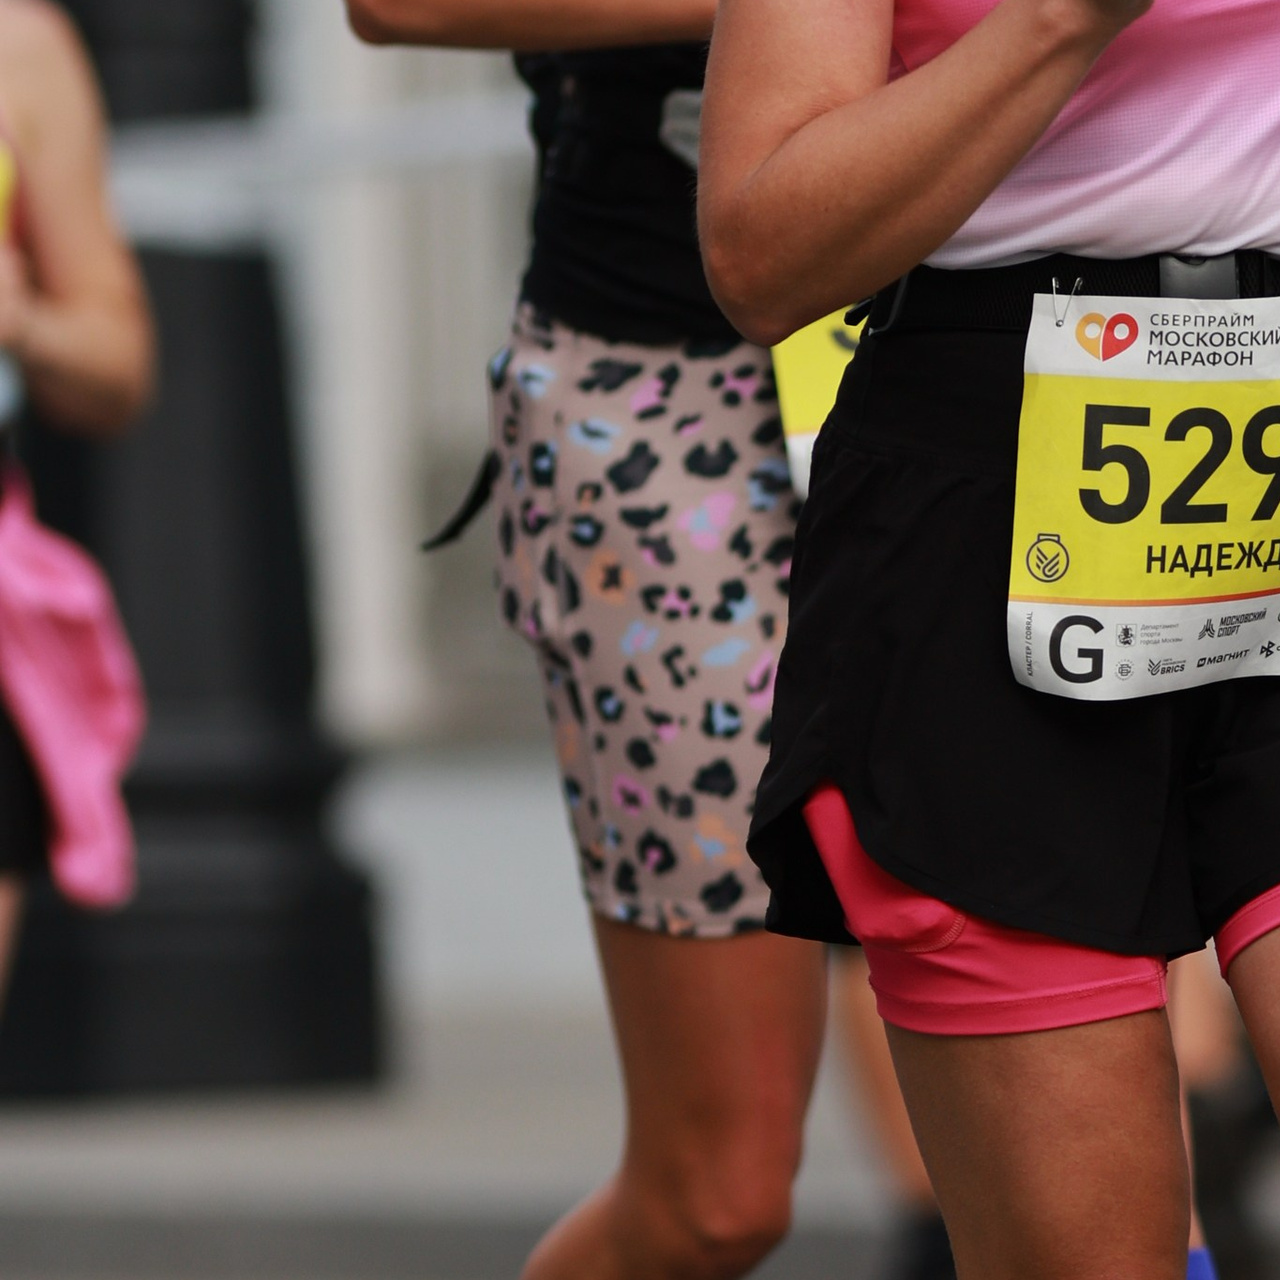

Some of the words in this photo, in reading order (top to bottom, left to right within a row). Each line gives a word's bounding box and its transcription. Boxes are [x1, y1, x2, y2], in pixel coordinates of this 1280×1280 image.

[1149, 312, 1255, 328] СБЕРПРАЙМ
[1146, 349, 1254, 367] МАРАФОН
[1025, 611, 1034, 640] CORRAL
[1220, 607, 1267, 627] МОСКОВСКИЙ
[1216, 624, 1241, 638] СПОРТ
[1048, 614, 1105, 684] G
[1025, 645, 1034, 677] КЛАСТЕР
[1160, 663, 1186, 675] BRICS
